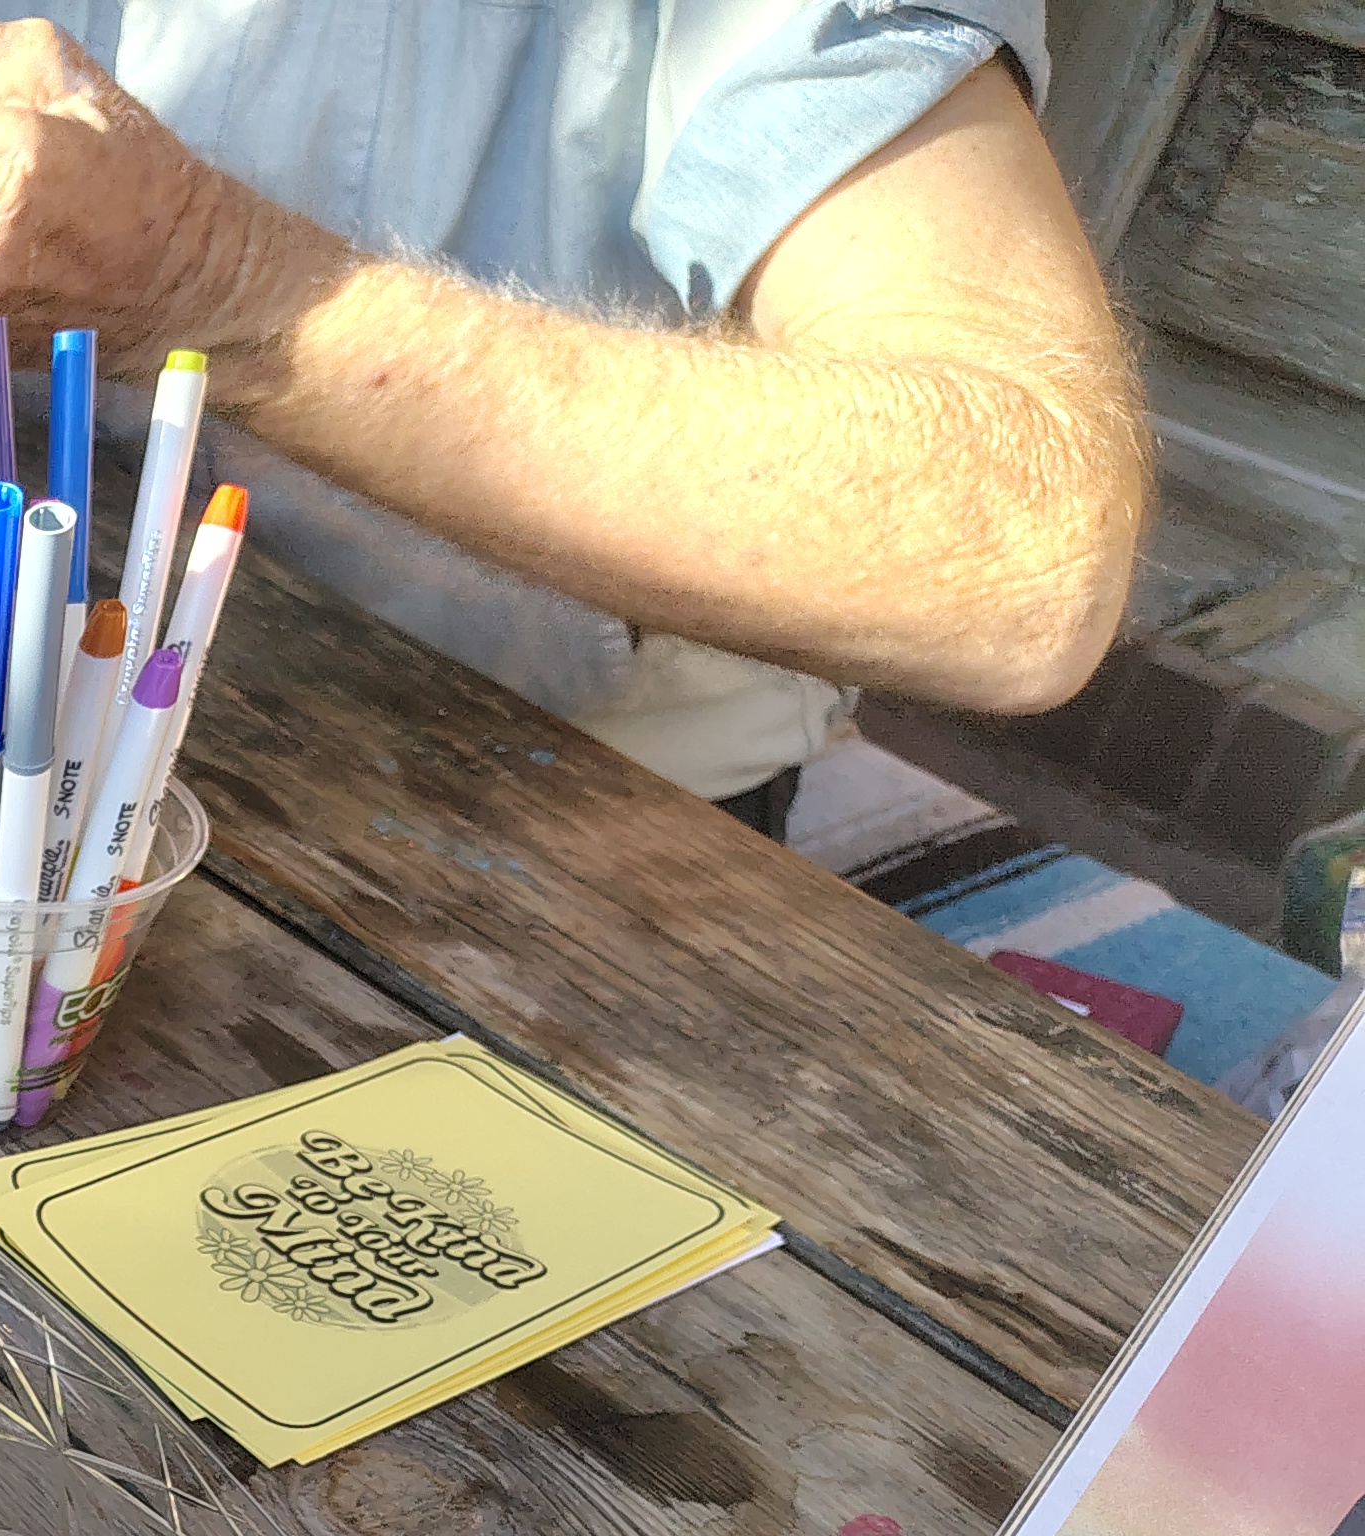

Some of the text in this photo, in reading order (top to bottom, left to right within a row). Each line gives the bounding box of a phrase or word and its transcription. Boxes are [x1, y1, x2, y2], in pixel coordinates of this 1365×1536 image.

[199, 1184, 436, 1324] Mind
[283, 1174, 441, 1278] To Your
[294, 1129, 548, 1291] Be Kind
